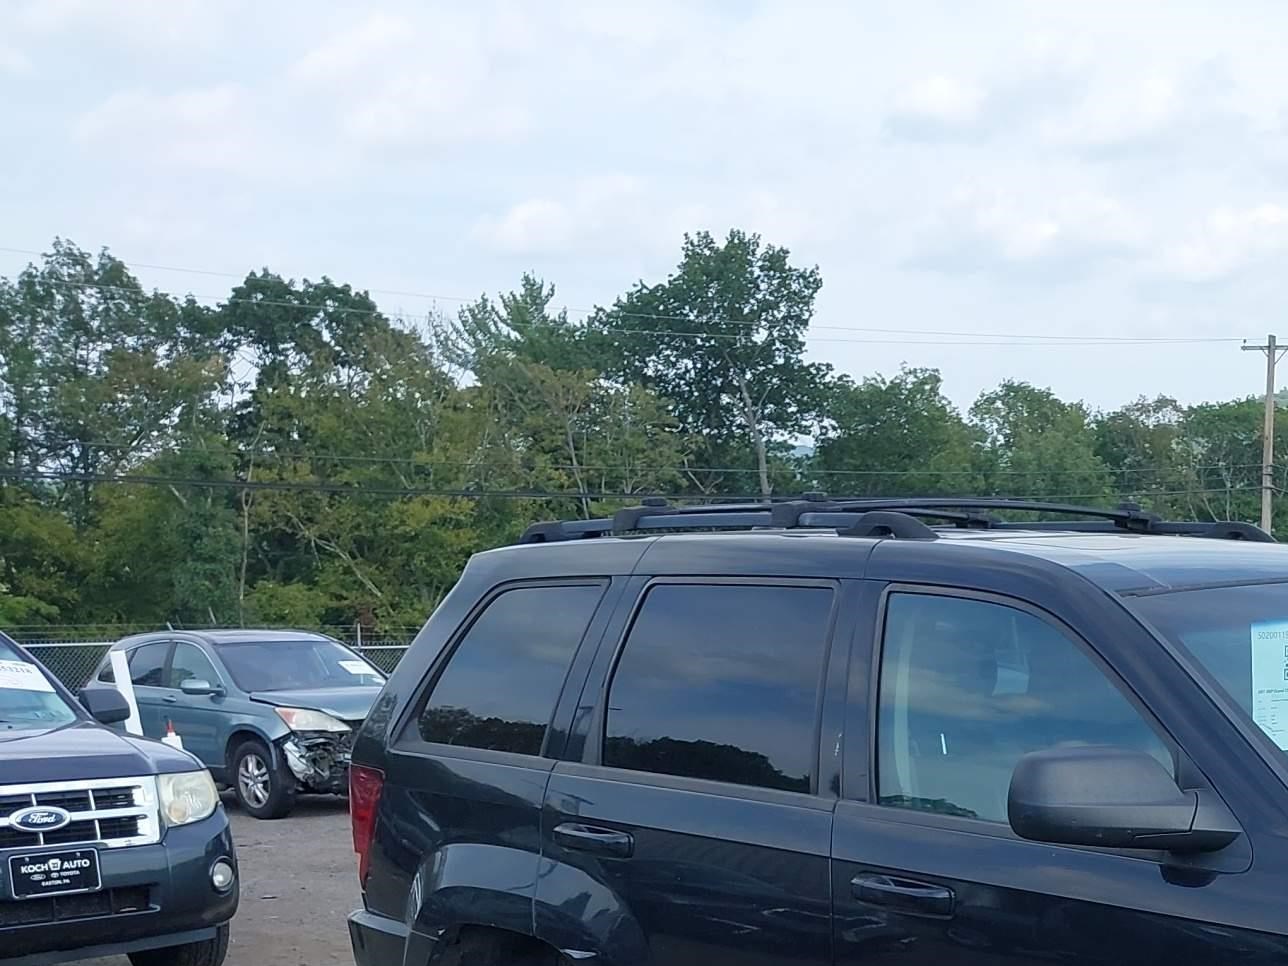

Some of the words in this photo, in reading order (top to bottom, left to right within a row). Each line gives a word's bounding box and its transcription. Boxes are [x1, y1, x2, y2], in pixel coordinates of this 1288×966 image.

[28, 812, 57, 824] Ford
[20, 863, 49, 874] KOCH
[62, 859, 90, 870] AUTO
